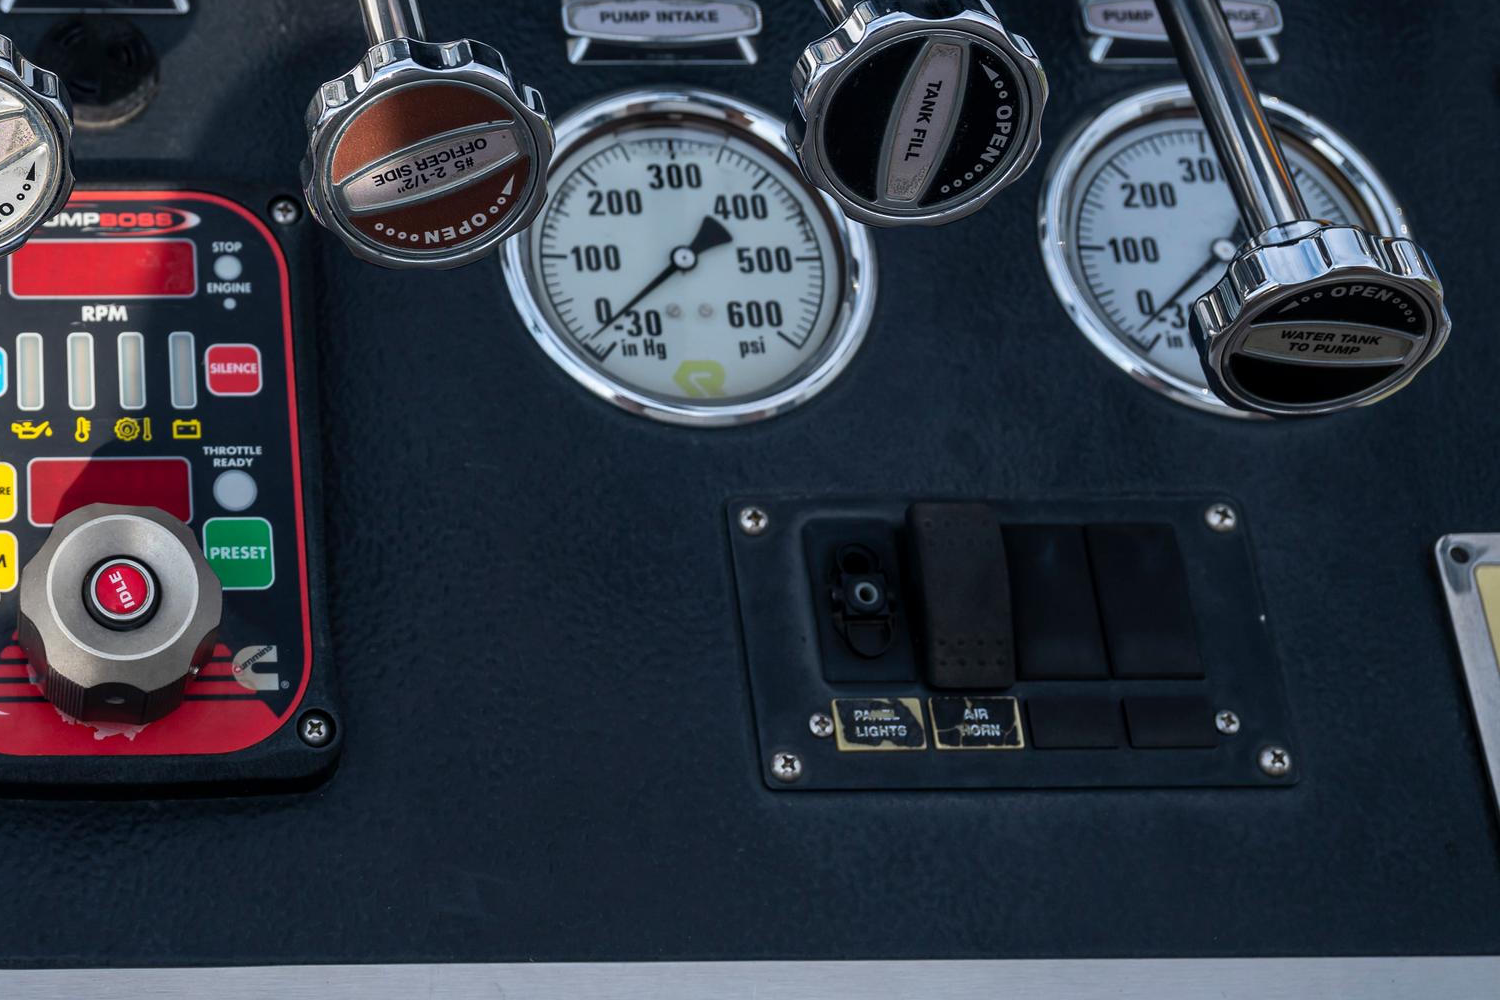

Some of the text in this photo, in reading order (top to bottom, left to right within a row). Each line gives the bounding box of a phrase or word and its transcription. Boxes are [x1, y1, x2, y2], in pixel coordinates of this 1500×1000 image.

[600, 9, 719, 24] PUMP INTAKE
[1102, 9, 1153, 23] PUMP
[903, 80, 943, 162] TANK FILL
[980, 105, 1013, 164] OPEN
[372, 137, 488, 188] OFFICER SIDE
[454, 157, 475, 172] #5
[1178, 157, 1228, 184] 30
[647, 163, 702, 190] 300
[588, 189, 643, 216] 200
[1121, 182, 1177, 208] 200
[713, 194, 768, 221] 400
[42, 212, 173, 228] UMPBOSS
[424, 212, 488, 246] OPEN
[212, 241, 242, 253] STOP
[570, 245, 621, 272] 100
[1108, 237, 1160, 264] 100
[737, 247, 793, 274] 500
[206, 282, 251, 294] ENGINE
[1330, 285, 1394, 302] OPEN
[81, 305, 128, 322] RPM
[595, 298, 612, 325] 0
[727, 300, 783, 328] 600
[1136, 289, 1155, 316] 0
[614, 309, 663, 338] -30
[1157, 303, 1192, 330] -3
[621, 338, 667, 360] in Hg
[739, 336, 766, 359] psi
[1280, 330, 1383, 346] WATER TANK
[1288, 342, 1361, 355] TO PUMP
[209, 362, 258, 374] SILENCE
[202, 445, 262, 456] THROTTLE
[212, 458, 254, 468] READY
[209, 546, 267, 560] PRESET
[108, 570, 136, 609] IDLE
[963, 708, 989, 720] AIR
[856, 725, 907, 738] LIGHTS
[962, 724, 1001, 736] HORN
